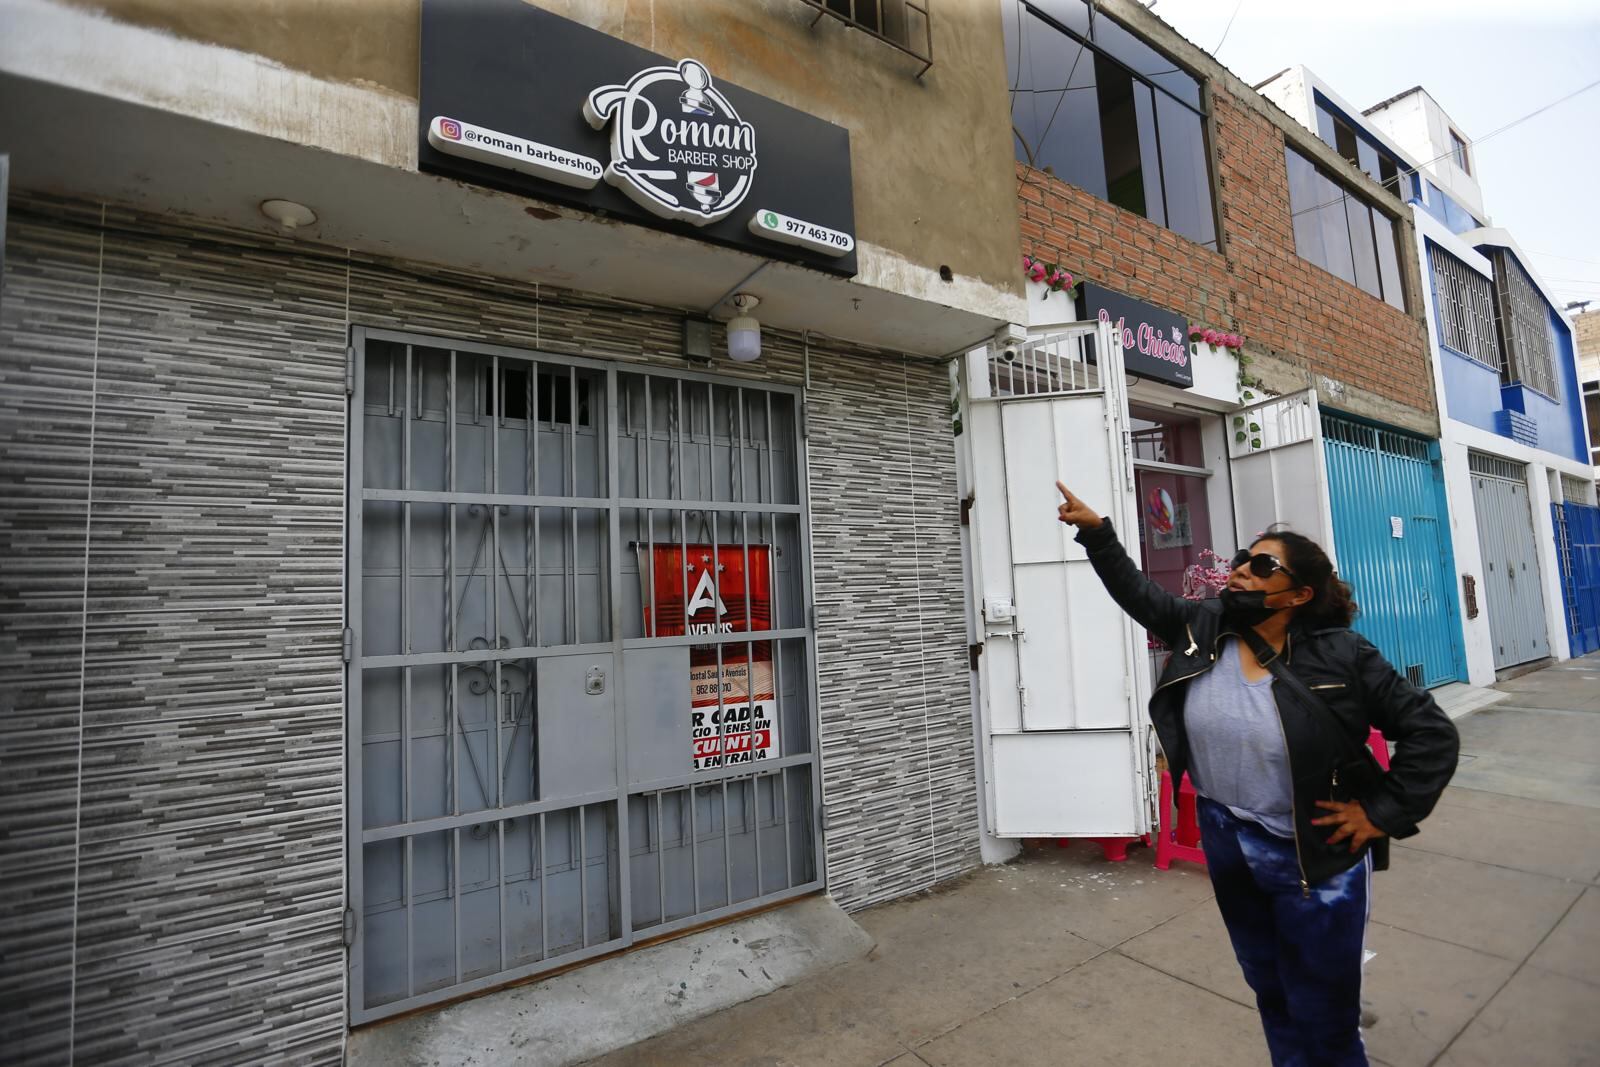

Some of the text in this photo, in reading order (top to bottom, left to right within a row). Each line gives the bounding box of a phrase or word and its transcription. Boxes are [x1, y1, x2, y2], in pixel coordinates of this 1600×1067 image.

[595, 90, 752, 162] Roman
[464, 130, 522, 153] @roman
[668, 148, 753, 170] BARBER SHOP
[786, 220, 849, 247] 977 463 709
[1137, 322, 1188, 367] Chicas
[711, 704, 764, 725] CADA
[755, 719, 771, 730] UN
